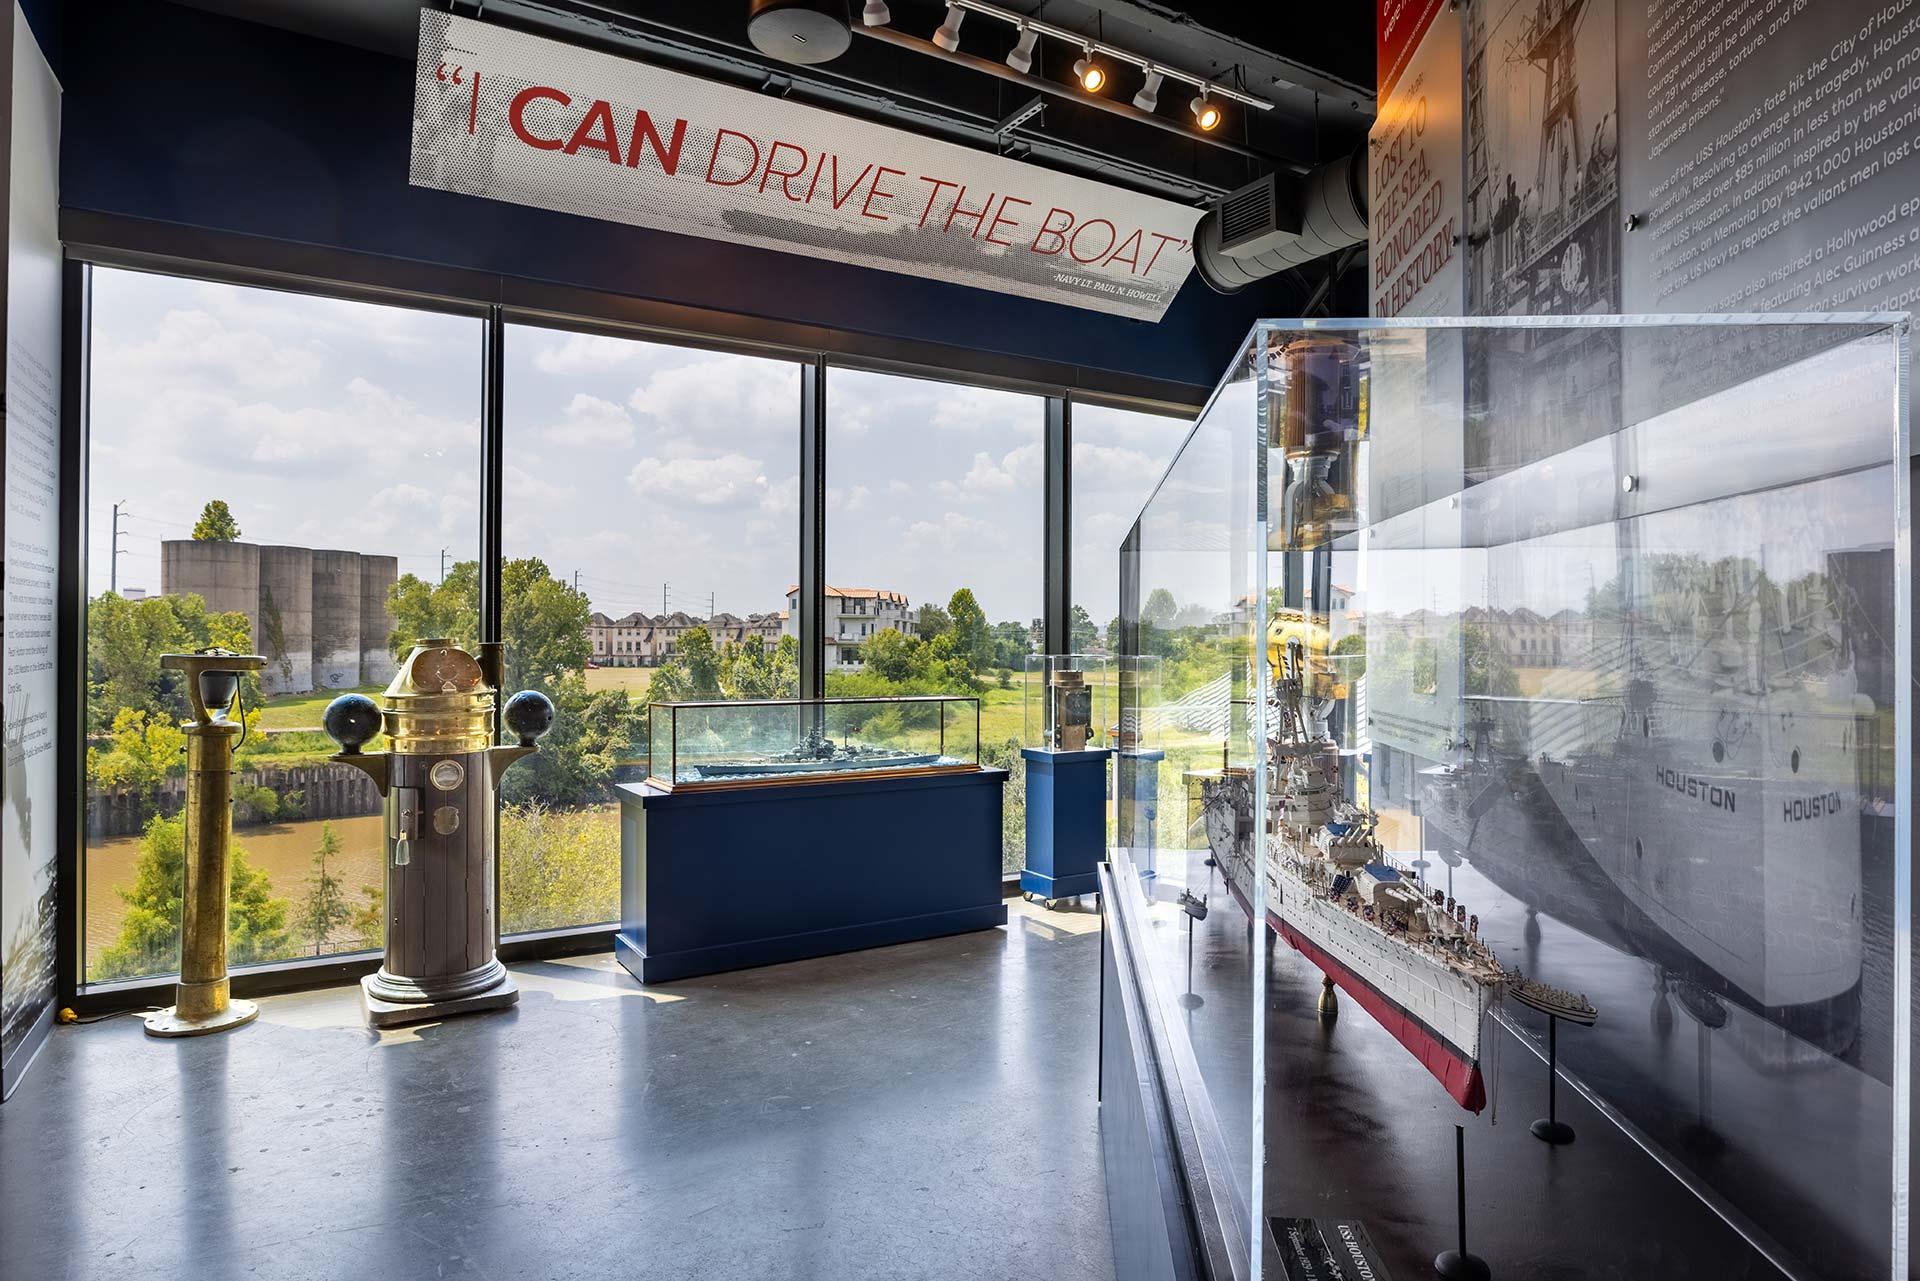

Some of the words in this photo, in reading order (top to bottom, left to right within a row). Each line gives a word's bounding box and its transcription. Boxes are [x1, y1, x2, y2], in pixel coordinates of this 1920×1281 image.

[1648, 15, 1664, 38] over
[1648, 15, 1685, 58] Houston's
[1648, 34, 1688, 78] Command
[1648, 64, 1679, 99] courage
[1680, 37, 1706, 68] would
[1708, 26, 1720, 43] be
[1648, 99, 1664, 120] only
[1665, 85, 1679, 105] 291
[1680, 59, 1705, 91] would
[1707, 42, 1723, 66] still
[1725, 33, 1738, 51] be
[1740, 9, 1764, 37] alive
[1648, 100, 1690, 141] starvation,
[1691, 67, 1727, 103] disease,
[1729, 34, 1766, 70] torture,
[1769, 6, 1790, 35] and
[1375, 126, 1405, 202] LOST
[1407, 95, 1428, 152] TO
[1648, 122, 1687, 160] Japanese
[1649, 179, 1669, 200] News
[1670, 170, 1679, 185] of
[1680, 160, 1694, 178] the
[1696, 142, 1713, 165] USS
[1715, 108, 1762, 151] Houston's
[1764, 88, 1786, 115] fate
[1789, 74, 1805, 95] hit
[1807, 58, 1828, 81] the
[1831, 35, 1857, 62] City
[1860, 17, 1875, 41] of
[1685, 190, 1711, 217] raised
[1713, 175, 1733, 198] over
[1735, 159, 1753, 183] $85
[1756, 136, 1791, 169] million
[1793, 128, 1804, 143] in
[1807, 109, 1829, 134] less
[1832, 87, 1862, 116] than
[1866, 66, 1893, 93] two
[1693, 151, 1735, 190] Resolving
[1737, 143, 1748, 158] to
[1750, 111, 1790, 148] avenge
[1792, 94, 1812, 117] the
[1815, 55, 1869, 101] tragedy,
[508, 86, 687, 176] CAN
[705, 128, 906, 221] DRIVE
[919, 176, 1032, 247] THE
[1375, 184, 1399, 245] THE
[1401, 147, 1432, 212] SEA,
[1674, 226, 1690, 247] USS
[1692, 203, 1730, 235] Houston.
[1732, 195, 1742, 208] In
[1744, 164, 1791, 201] addition,
[1793, 123, 1840, 169] inspired
[1844, 115, 1861, 136] by
[1863, 99, 1887, 122] the
[1690, 262, 1702, 280] US
[1703, 250, 1727, 272] Navy
[1728, 244, 1739, 257] to
[1741, 216, 1780, 250] replace
[1782, 207, 1801, 227] the
[1803, 179, 1847, 213] valiant
[1849, 160, 1880, 187] men
[1884, 140, 1910, 168] lost
[1701, 238, 1712, 251] on
[1714, 203, 1759, 243] Memorial
[1762, 192, 1783, 214] Day
[1785, 170, 1812, 198] 1942
[1815, 147, 1851, 181] 1,000
[1375, 178, 1443, 291] HONORED
[1719, 289, 1743, 310] saga
[1745, 278, 1766, 297] also
[1768, 249, 1811, 285] inspired
[1815, 248, 1824, 259] a
[1826, 204, 1896, 256] Hollywood
[1760, 279, 1812, 312] featuring
[1814, 267, 1841, 288] Alec
[1843, 232, 1905, 273] Guinness
[1053, 273, 1082, 285] -NAVY
[1081, 280, 1093, 288] LT.
[1094, 281, 1115, 294] PAUL
[1115, 287, 1126, 296] N.
[1126, 288, 1161, 303] HOWELL
[1831, 271, 1883, 307] survivor
[1656, 763, 1736, 813] HOUSTON
[1783, 790, 1842, 823] HOUSTON
[1337, 1224, 1355, 1241] USS
